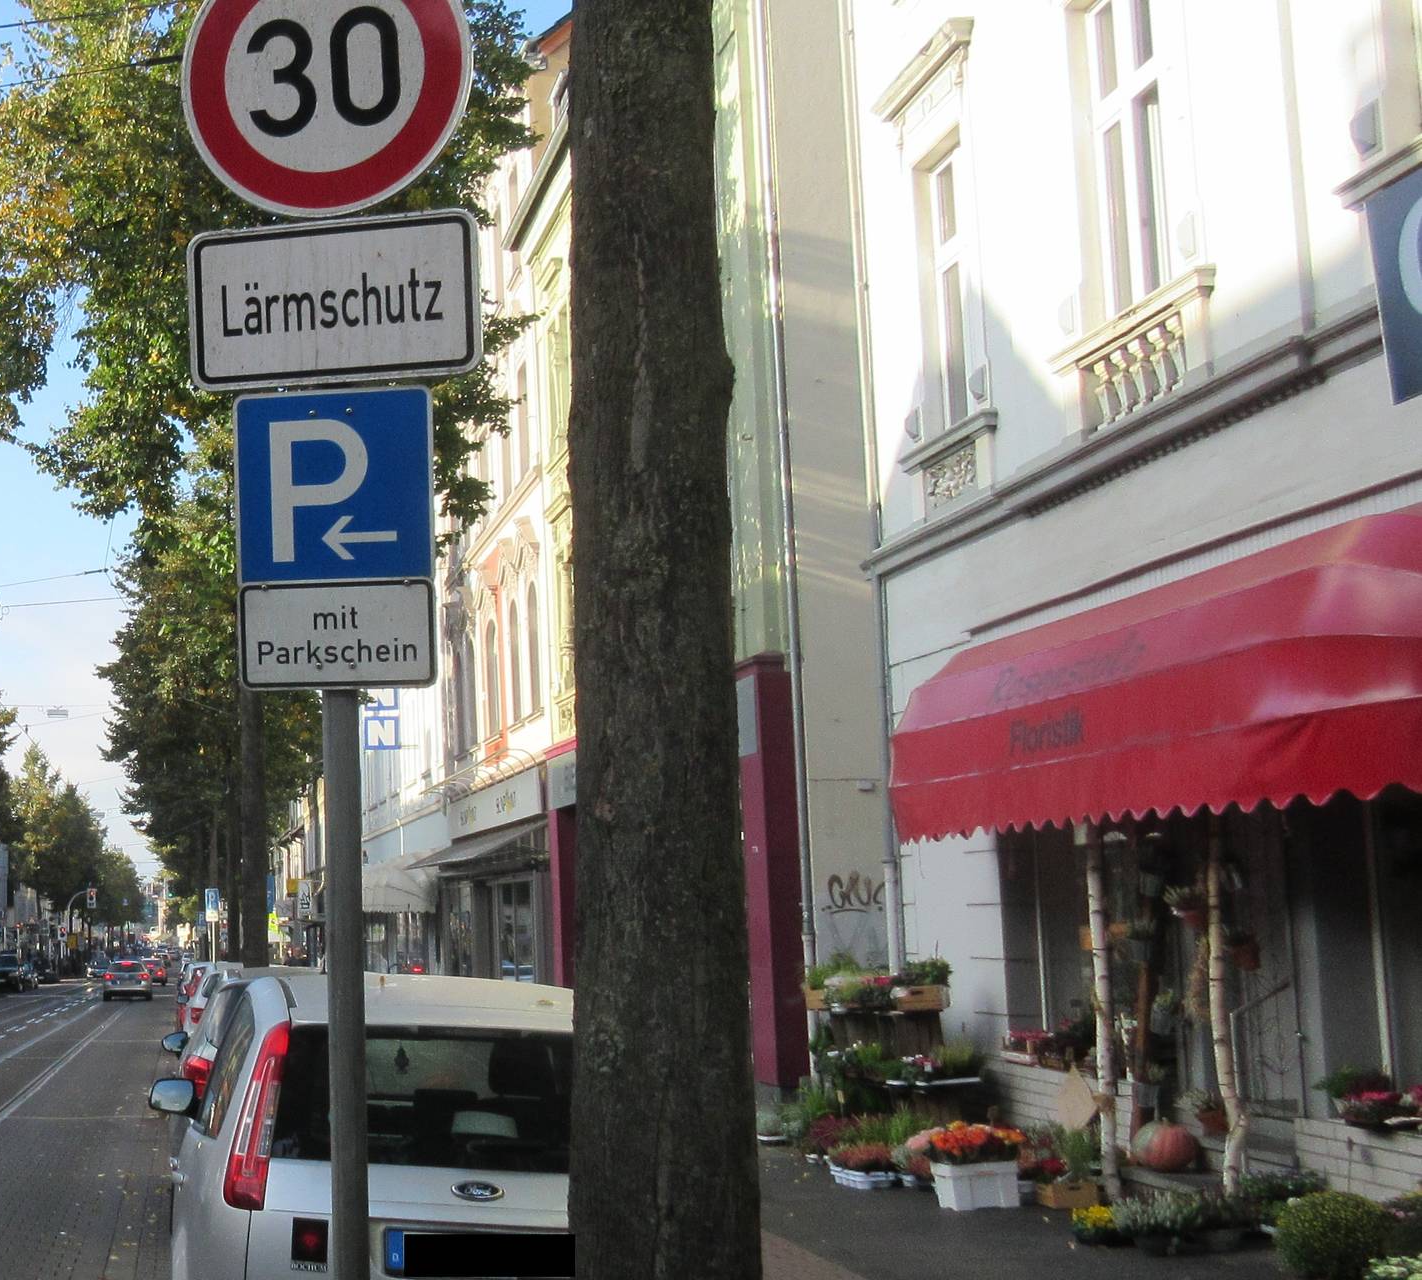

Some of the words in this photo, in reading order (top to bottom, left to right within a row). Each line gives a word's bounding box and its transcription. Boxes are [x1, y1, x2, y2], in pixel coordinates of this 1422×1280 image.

[247, 6, 401, 137] 30
[221, 268, 443, 337] Lärmschutz
[269, 419, 368, 563] P
[313, 605, 358, 630] mit
[257, 638, 417, 665] Parkschein
[1009, 705, 1084, 758] Floristik
